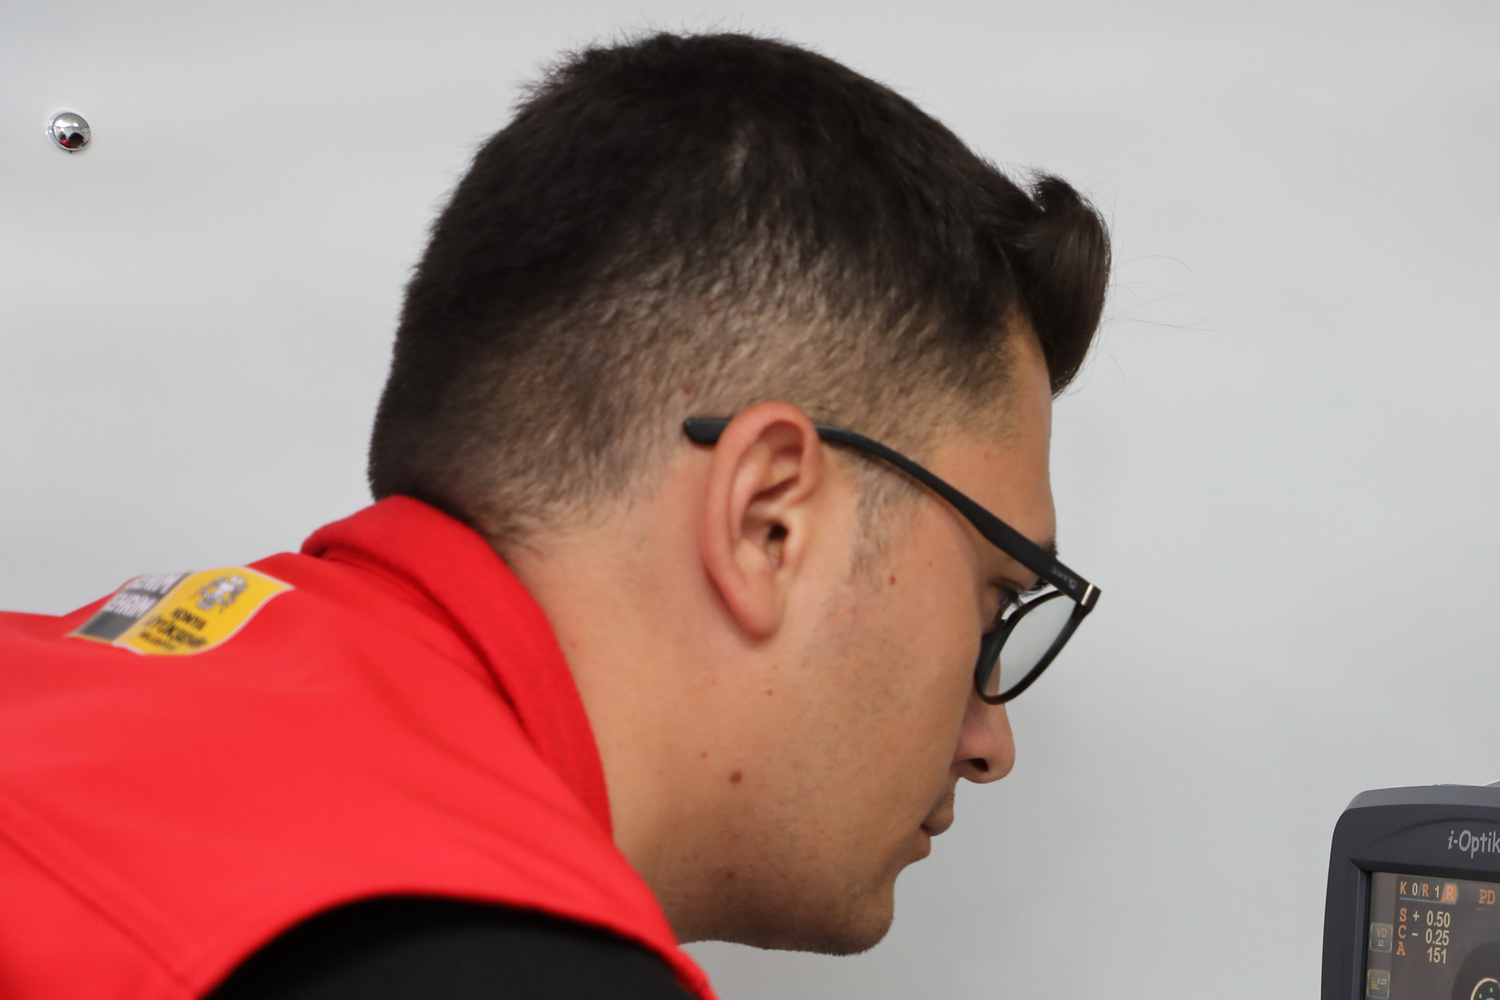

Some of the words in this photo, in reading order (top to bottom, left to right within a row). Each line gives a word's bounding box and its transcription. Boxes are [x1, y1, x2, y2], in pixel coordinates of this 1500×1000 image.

[1448, 829, 1500, 859] i-Optik
[1478, 889, 1496, 905] PD
[1426, 910, 1451, 928] 0.50
[1425, 928, 1450, 946] 0.25
[1427, 946, 1447, 964] 151
